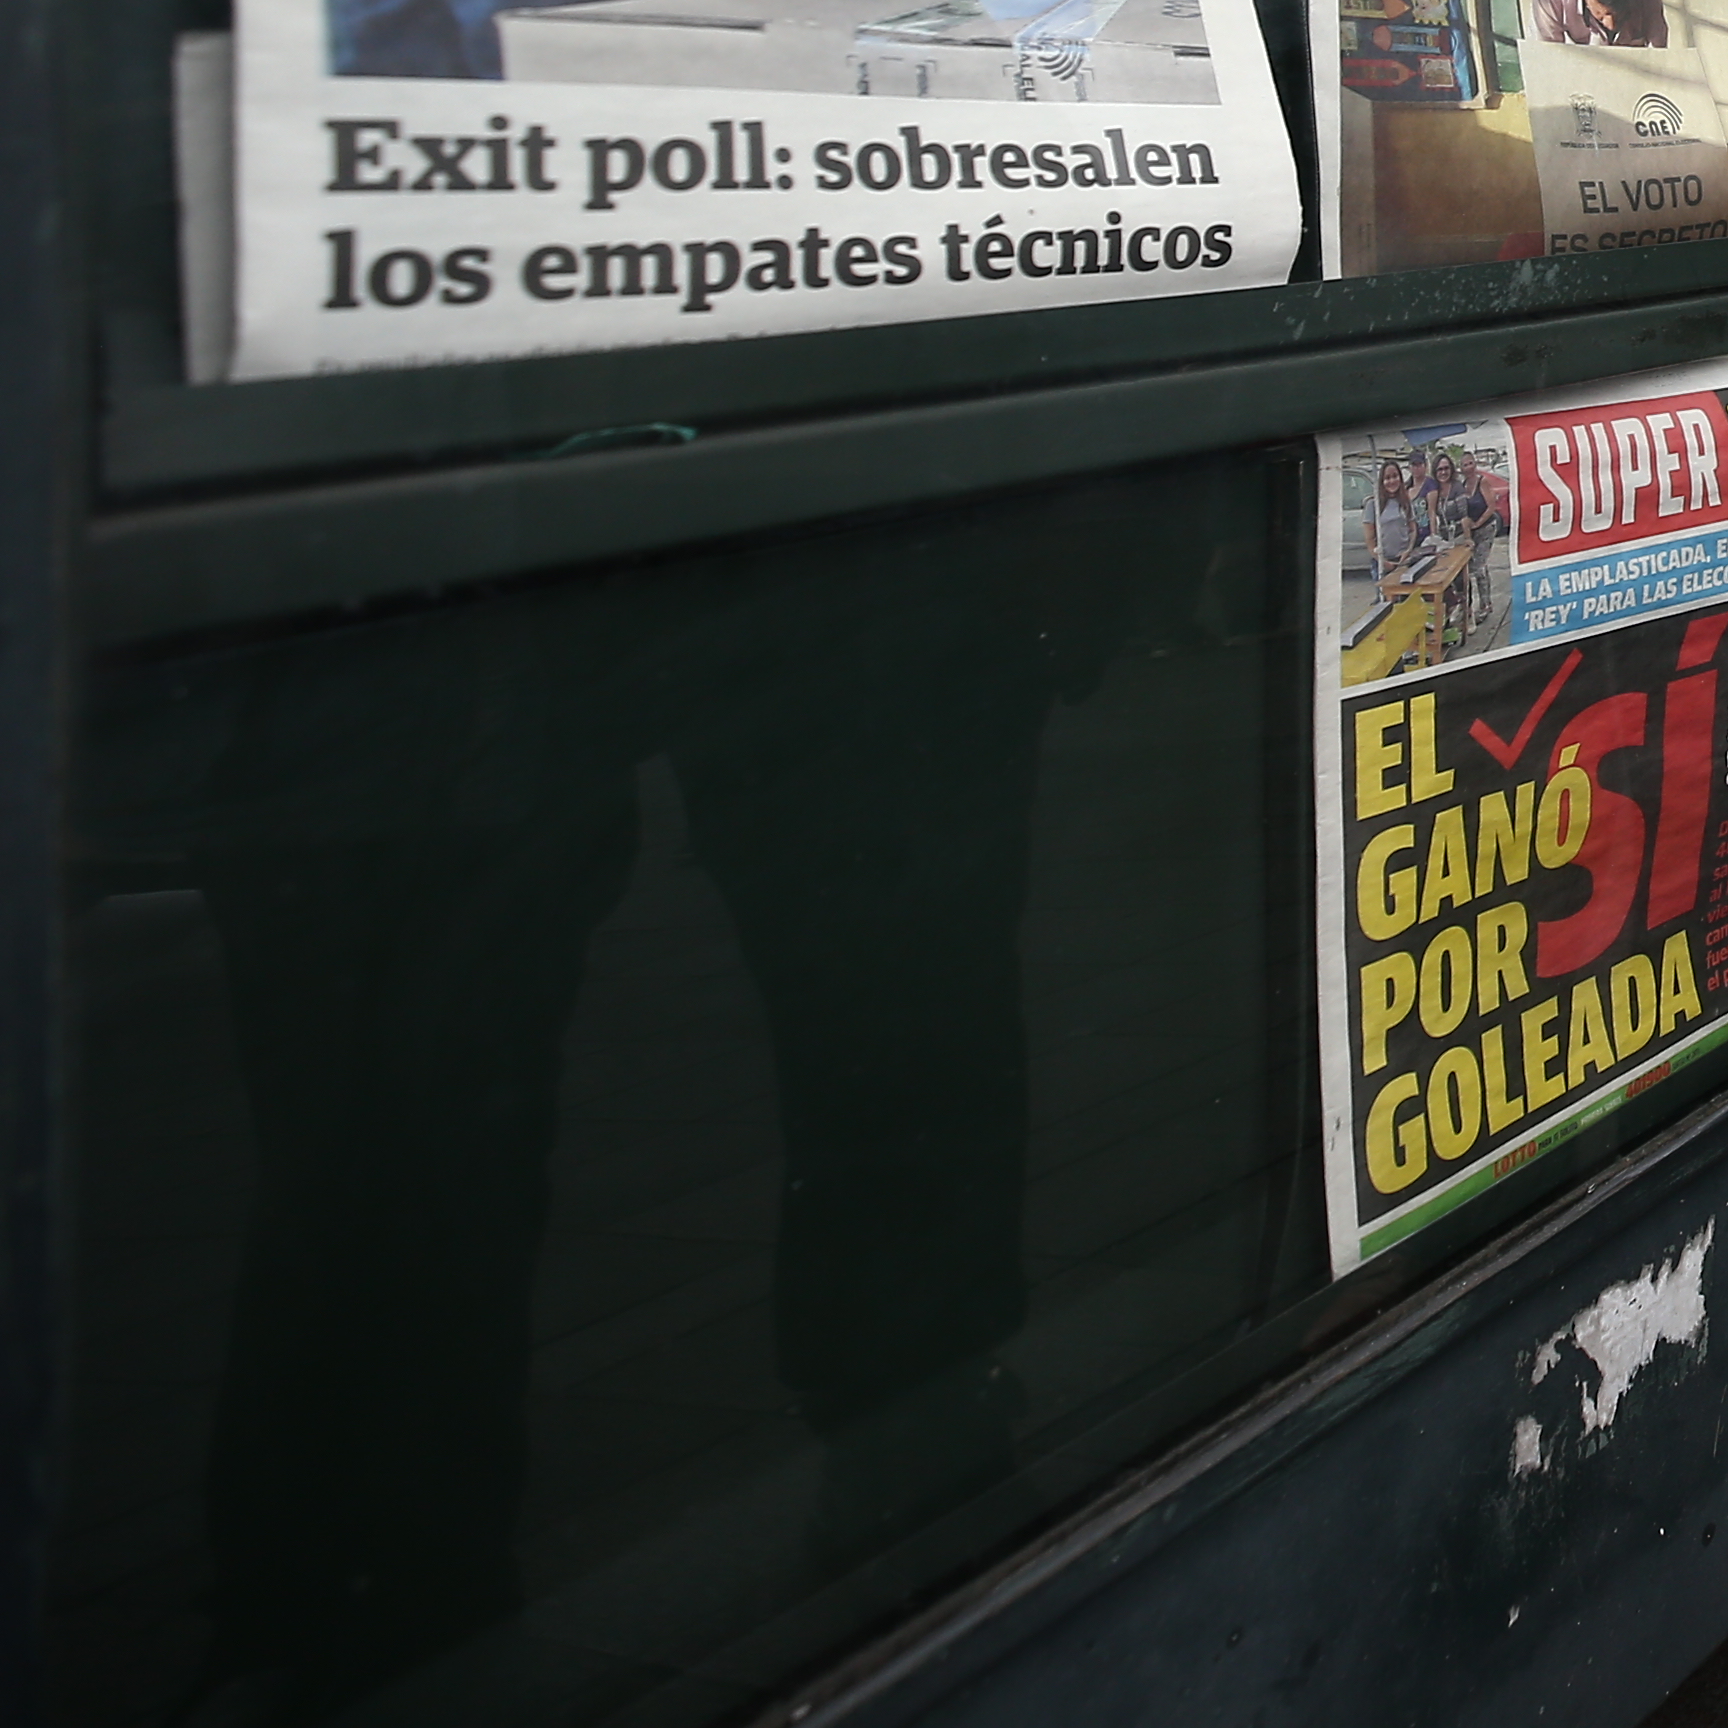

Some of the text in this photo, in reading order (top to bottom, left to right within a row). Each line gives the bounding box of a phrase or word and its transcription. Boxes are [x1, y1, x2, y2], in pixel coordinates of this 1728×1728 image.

[323, 116, 1220, 211] Exit poll: sobresalen
[1578, 175, 1703, 214] EL VOTO
[322, 210, 1234, 313] los empates técnicos
[1551, 233, 1588, 256] ES
[1533, 407, 1722, 543] SUPER
[1523, 601, 1578, 634] 'REY'
[1582, 587, 1637, 620] PARA
[1641, 576, 1678, 604] LAS
[1524, 578, 1554, 605] LA
[1558, 542, 1712, 595] EMPLASTICADA,
[1354, 691, 1456, 822] EL
[1356, 742, 1593, 942] GANÓ
[1708, 882, 1724, 904] al
[1360, 900, 1531, 1077] POR
[1706, 971, 1720, 992] el
[1364, 929, 1703, 1196] GOLEADA
[1493, 1140, 1538, 1180] LOTTO
